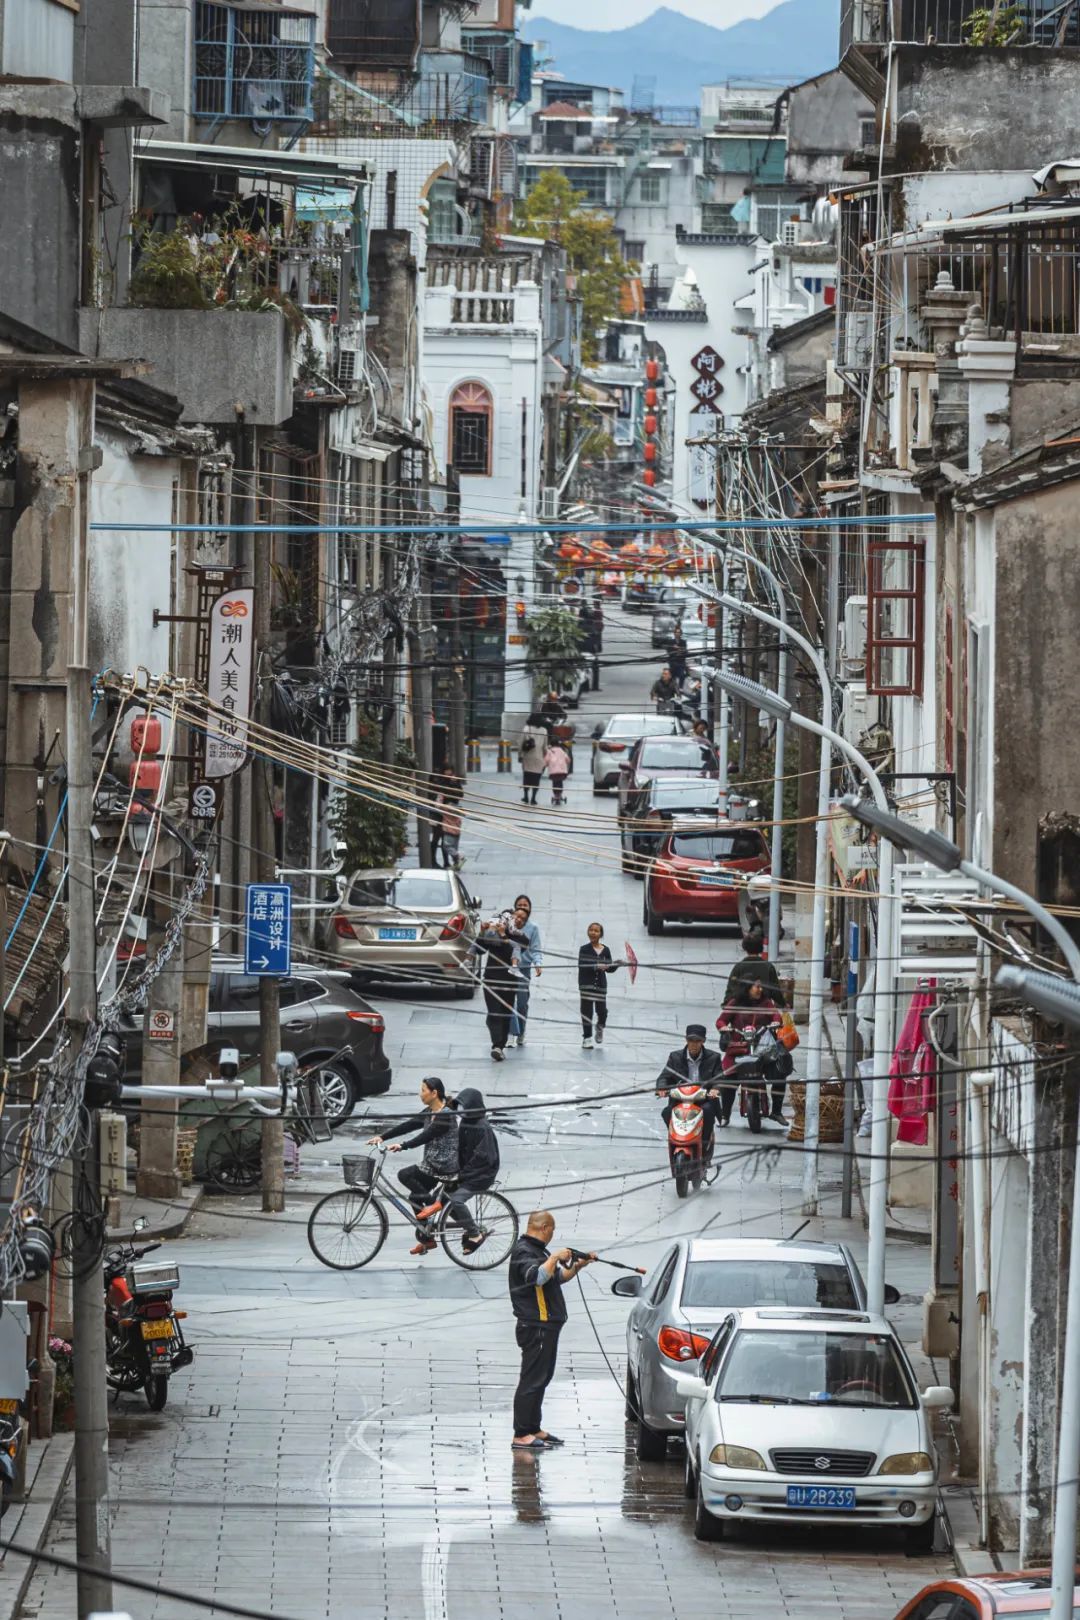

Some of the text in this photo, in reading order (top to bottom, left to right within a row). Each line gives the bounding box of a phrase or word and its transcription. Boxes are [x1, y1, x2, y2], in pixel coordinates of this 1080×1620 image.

[217, 622, 243, 739] 潮人美食城
[253, 891, 268, 920] 酒店
